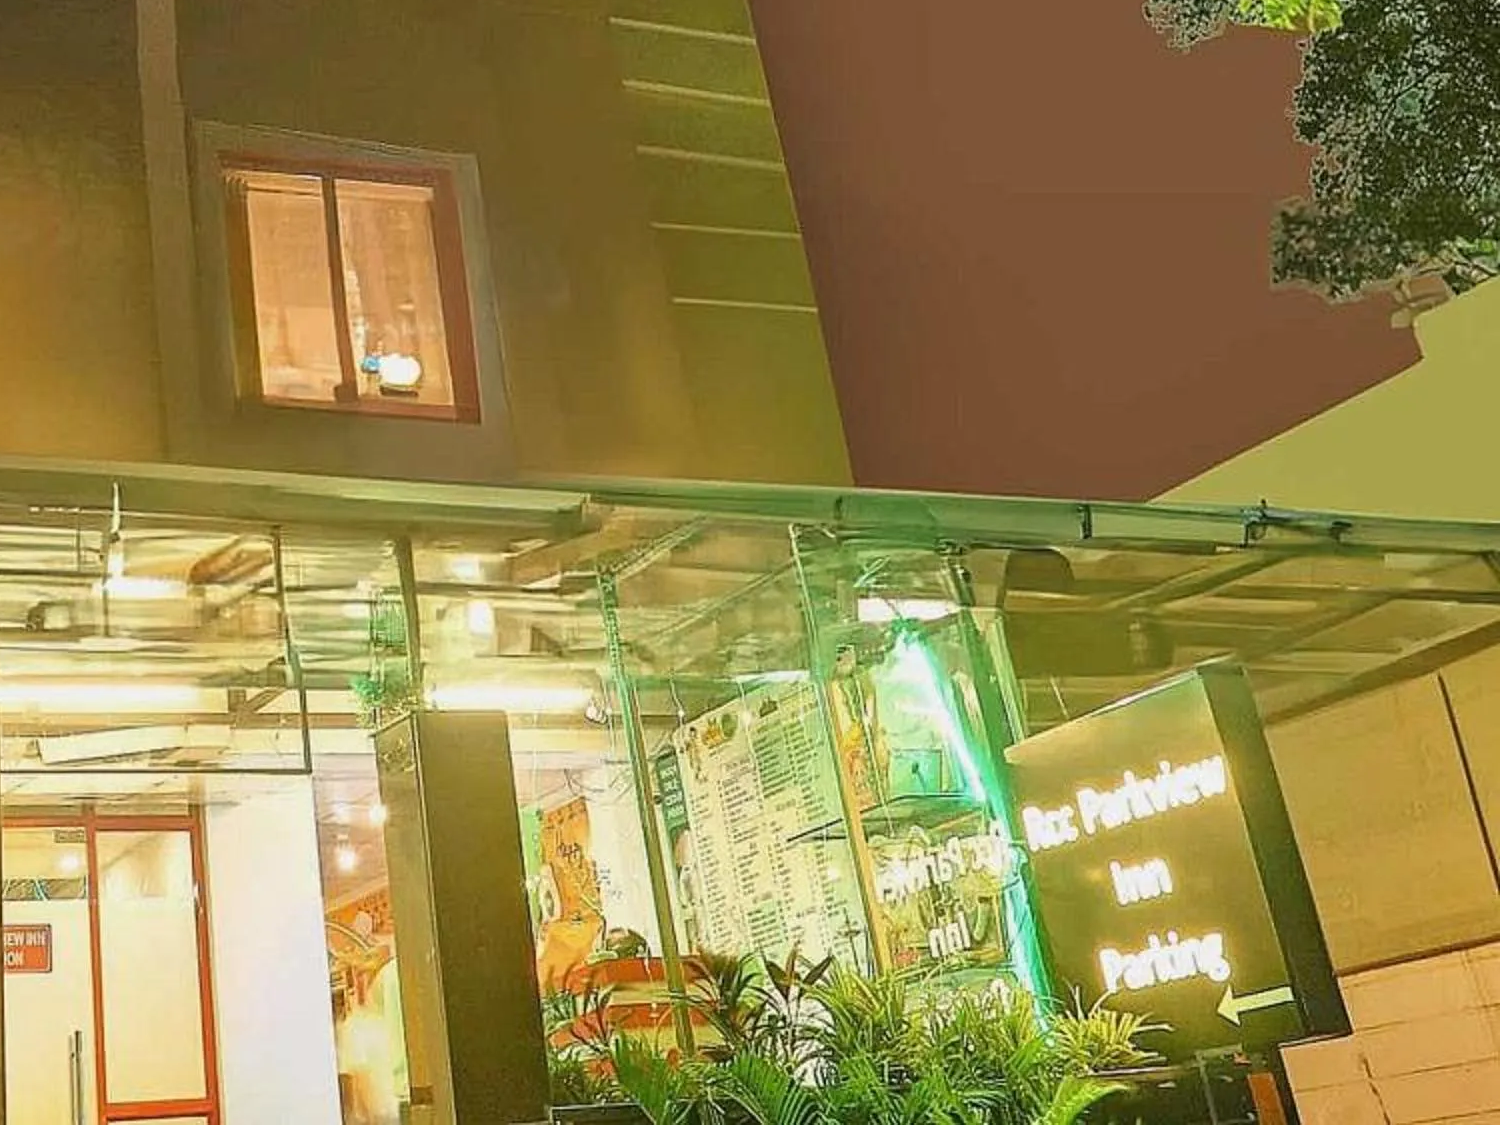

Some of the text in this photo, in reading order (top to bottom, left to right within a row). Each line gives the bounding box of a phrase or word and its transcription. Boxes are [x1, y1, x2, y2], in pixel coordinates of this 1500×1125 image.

[1076, 754, 1226, 835] Parkview
[1109, 859, 1173, 905] Inn
[3, 931, 24, 946] IEW
[3, 950, 24, 966] ION
[1099, 930, 1232, 993] Parking
